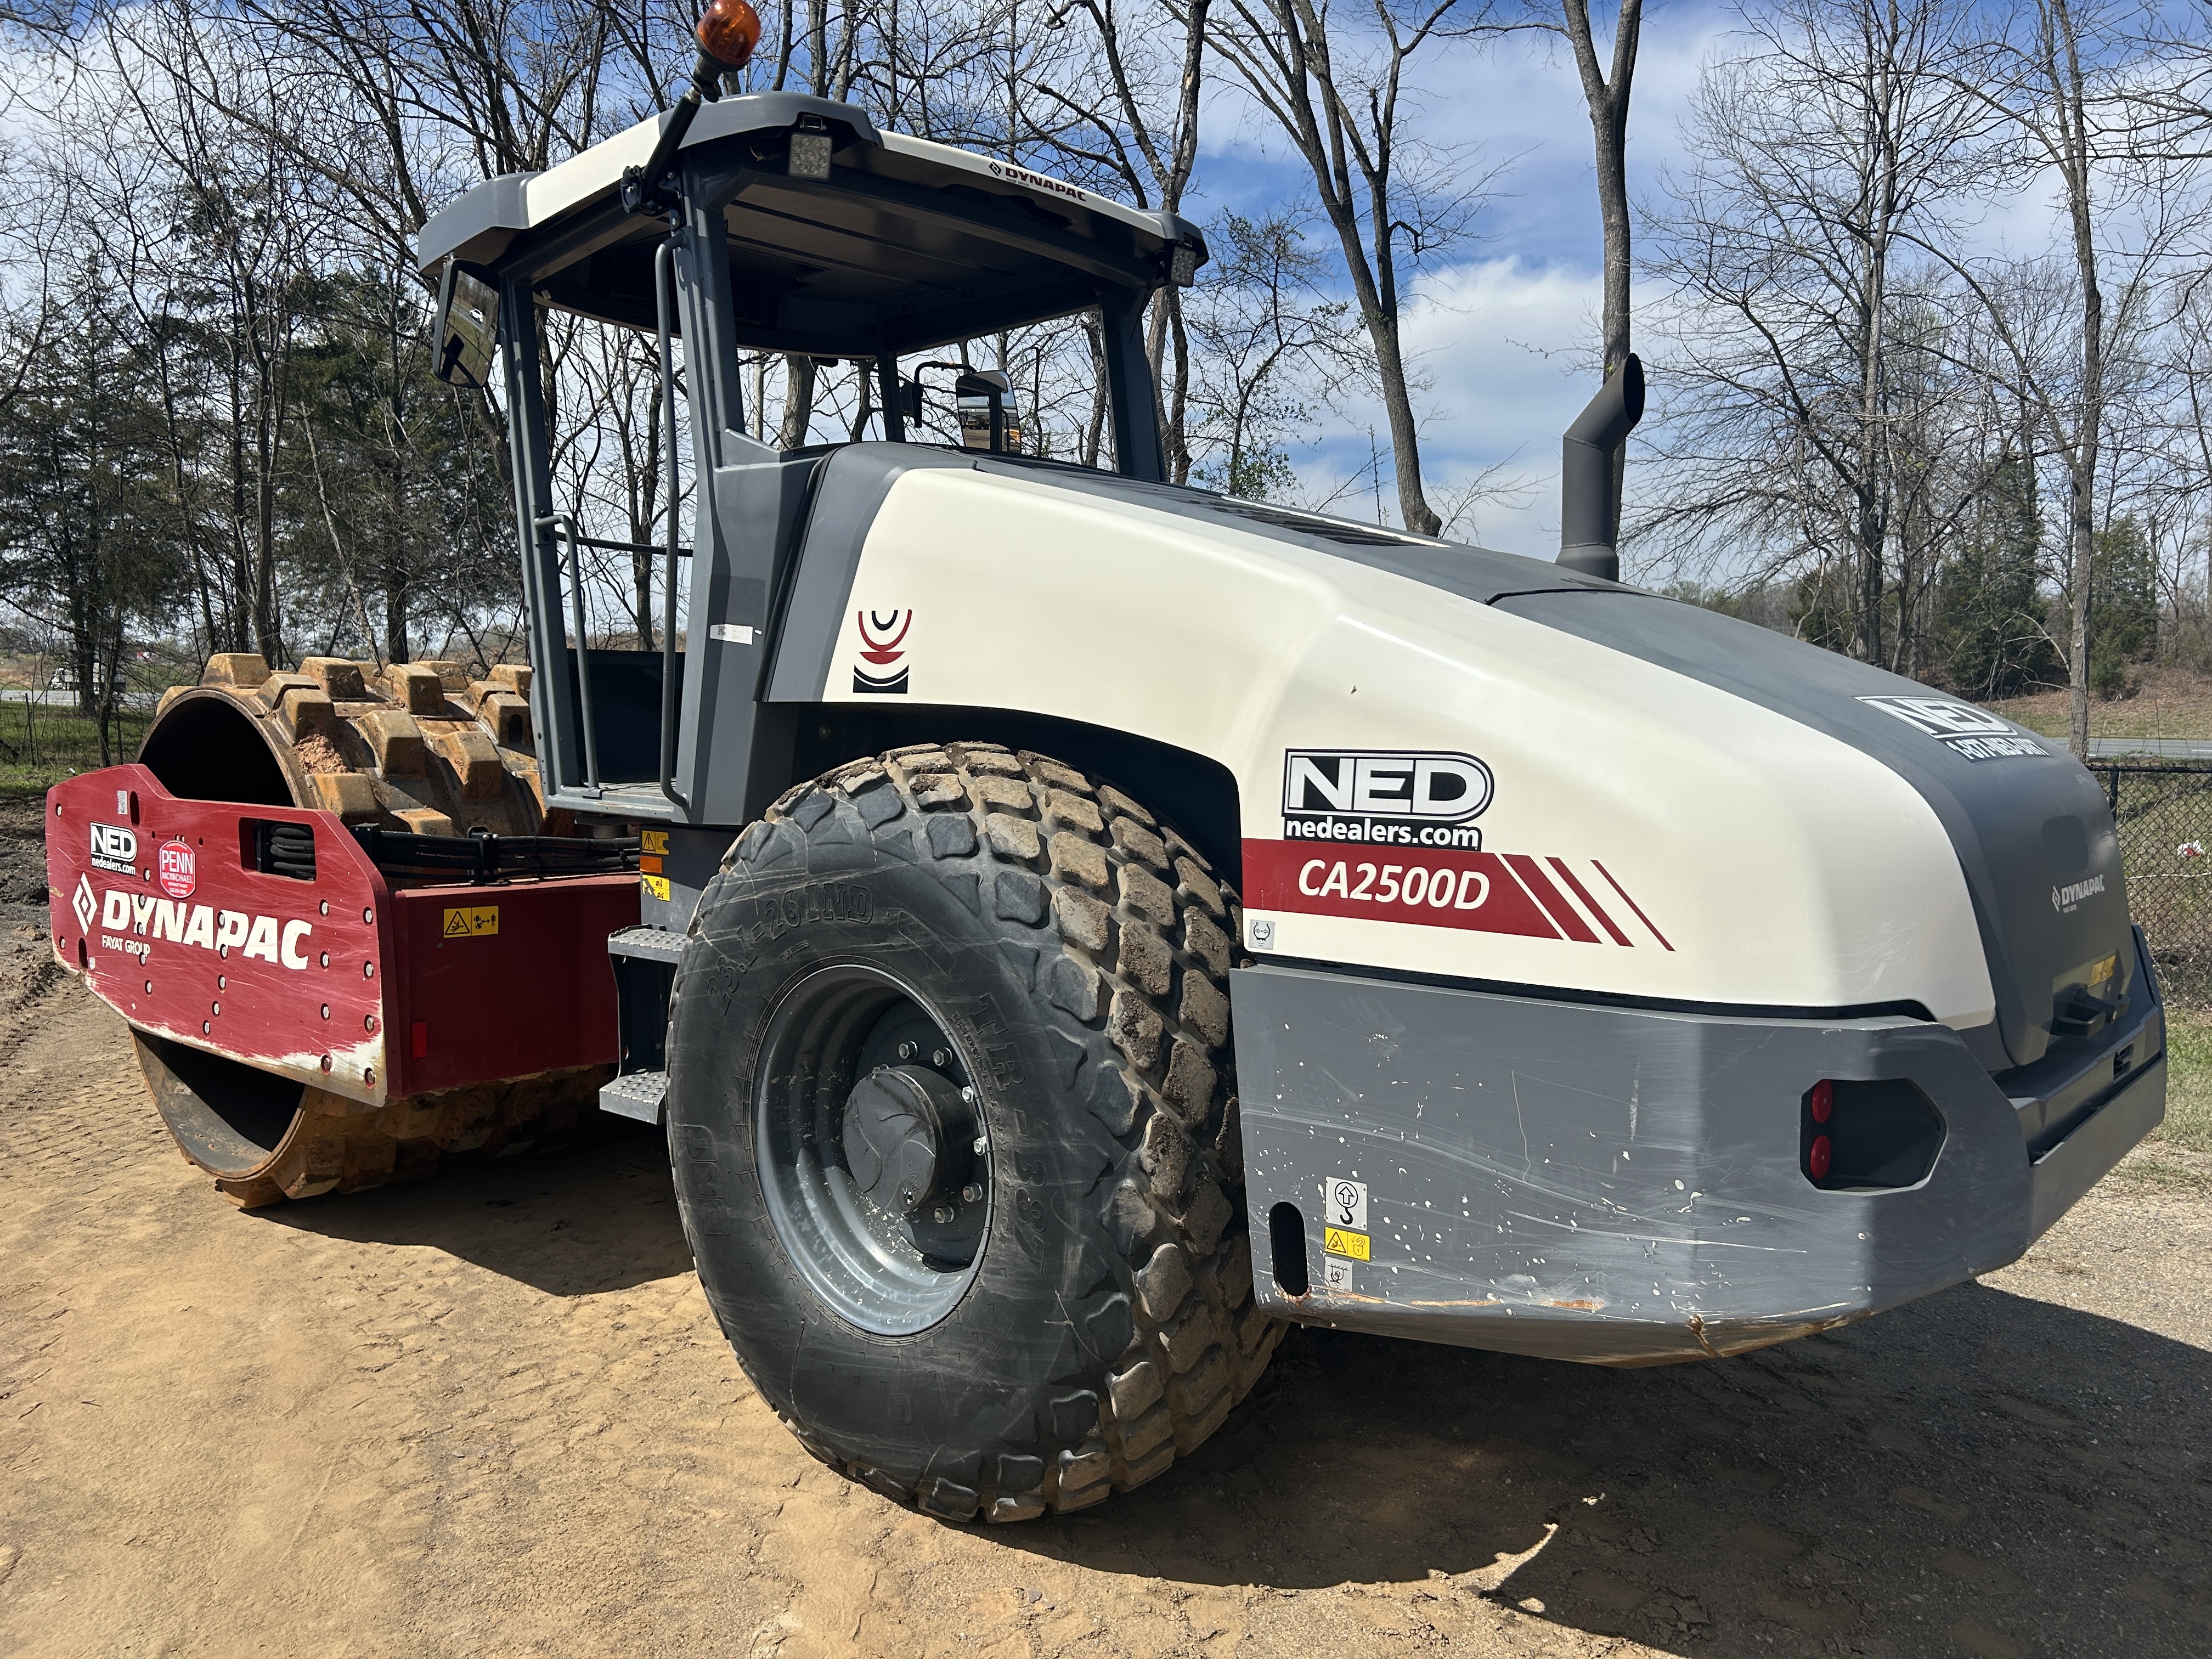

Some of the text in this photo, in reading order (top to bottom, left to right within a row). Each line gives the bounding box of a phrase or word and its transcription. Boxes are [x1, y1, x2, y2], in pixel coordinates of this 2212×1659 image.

[1005, 167, 1086, 202] DYNAPAC
[1864, 698, 2011, 734] NED
[1289, 757, 1487, 814] NED
[91, 825, 136, 860] NED
[1286, 816, 1479, 847] nedealers.com
[92, 856, 136, 876] nedealers.com
[161, 849, 194, 874] PENN
[1298, 859, 1490, 911] CA2500D
[2061, 873, 2105, 905] DYNAPAC
[101, 889, 313, 970] DYNAPAC
[101, 934, 151, 957] FAYAT GROUP
